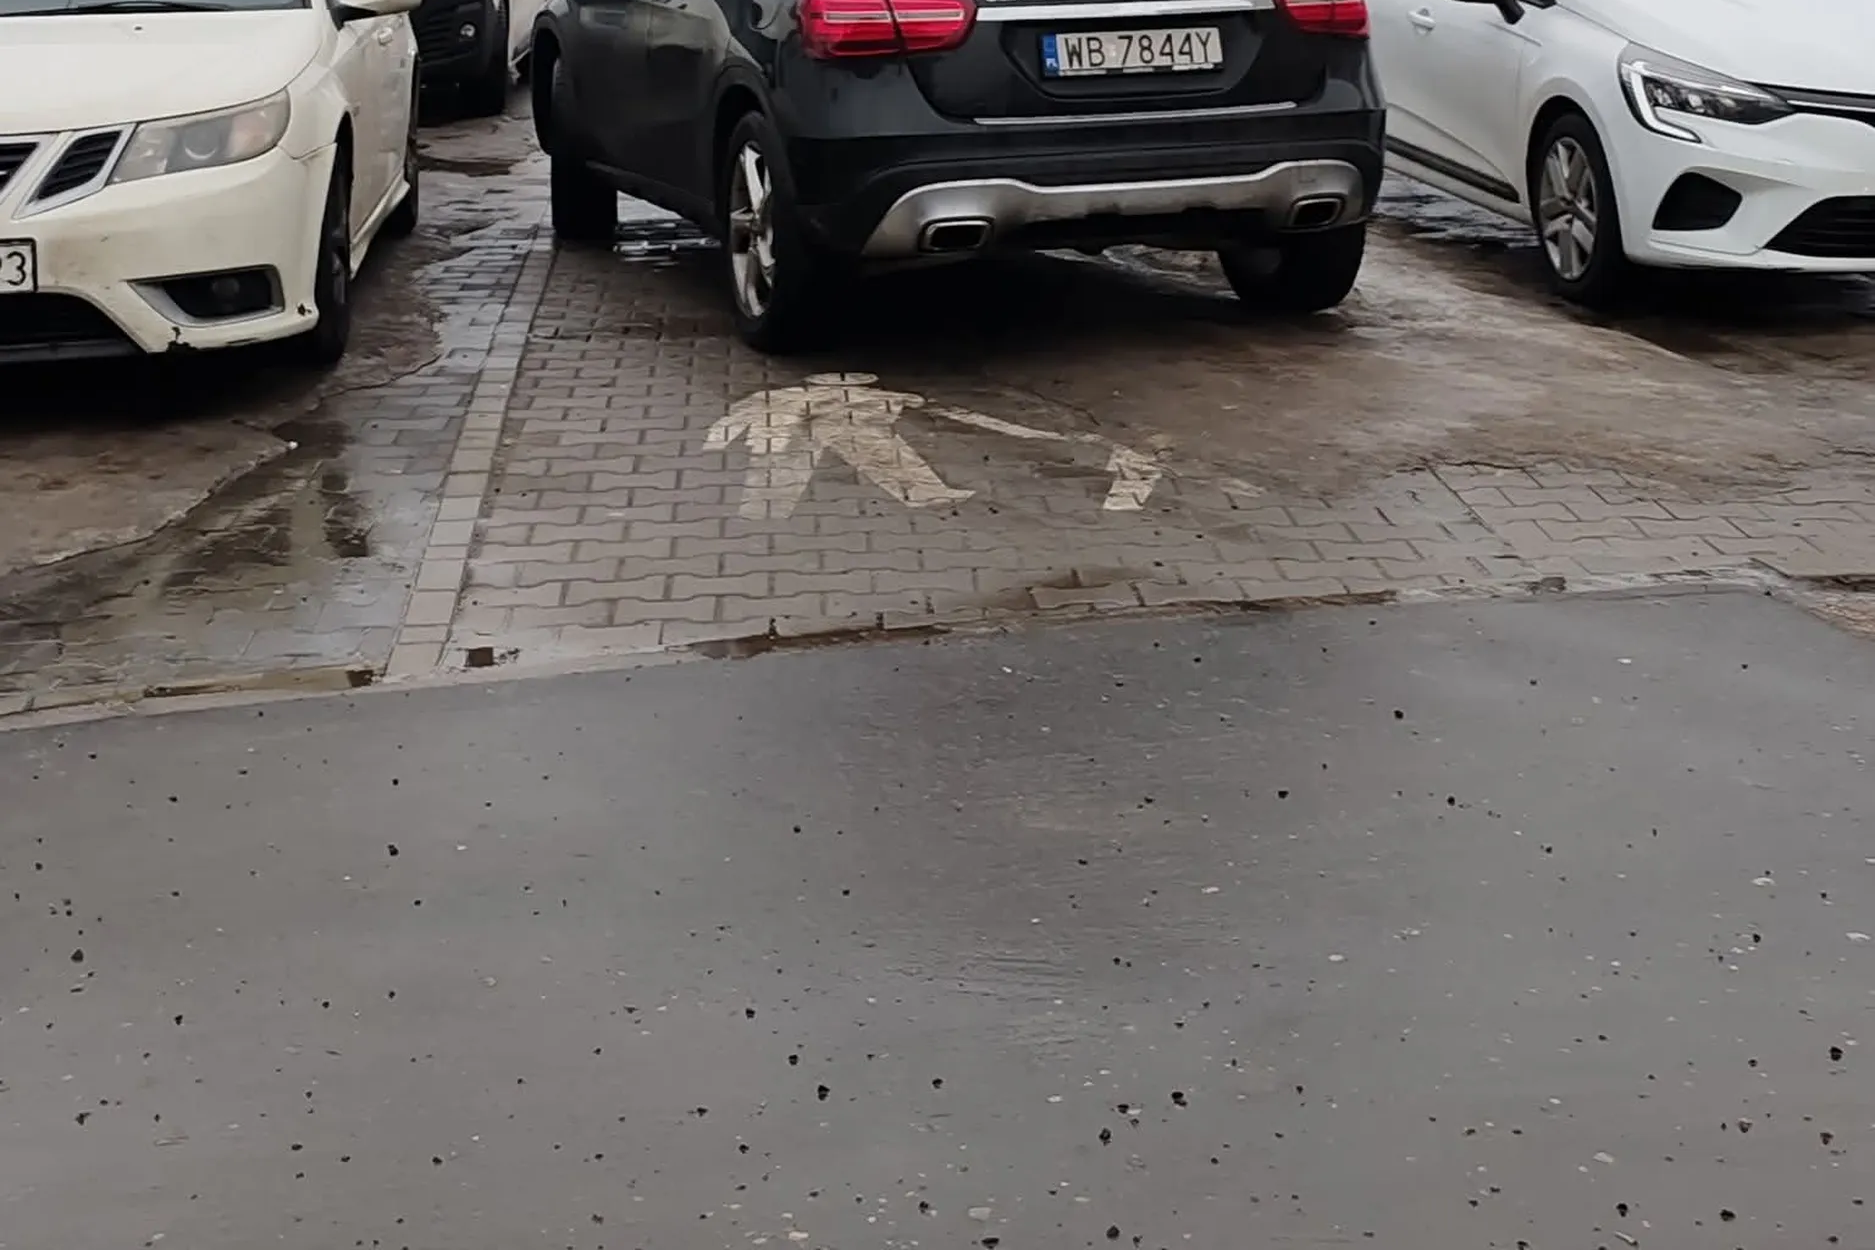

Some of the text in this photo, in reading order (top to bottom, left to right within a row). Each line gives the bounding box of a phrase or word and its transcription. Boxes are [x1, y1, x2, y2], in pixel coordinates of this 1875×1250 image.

[1064, 31, 1211, 68] WB 7844Y
[0, 251, 26, 286] 3
